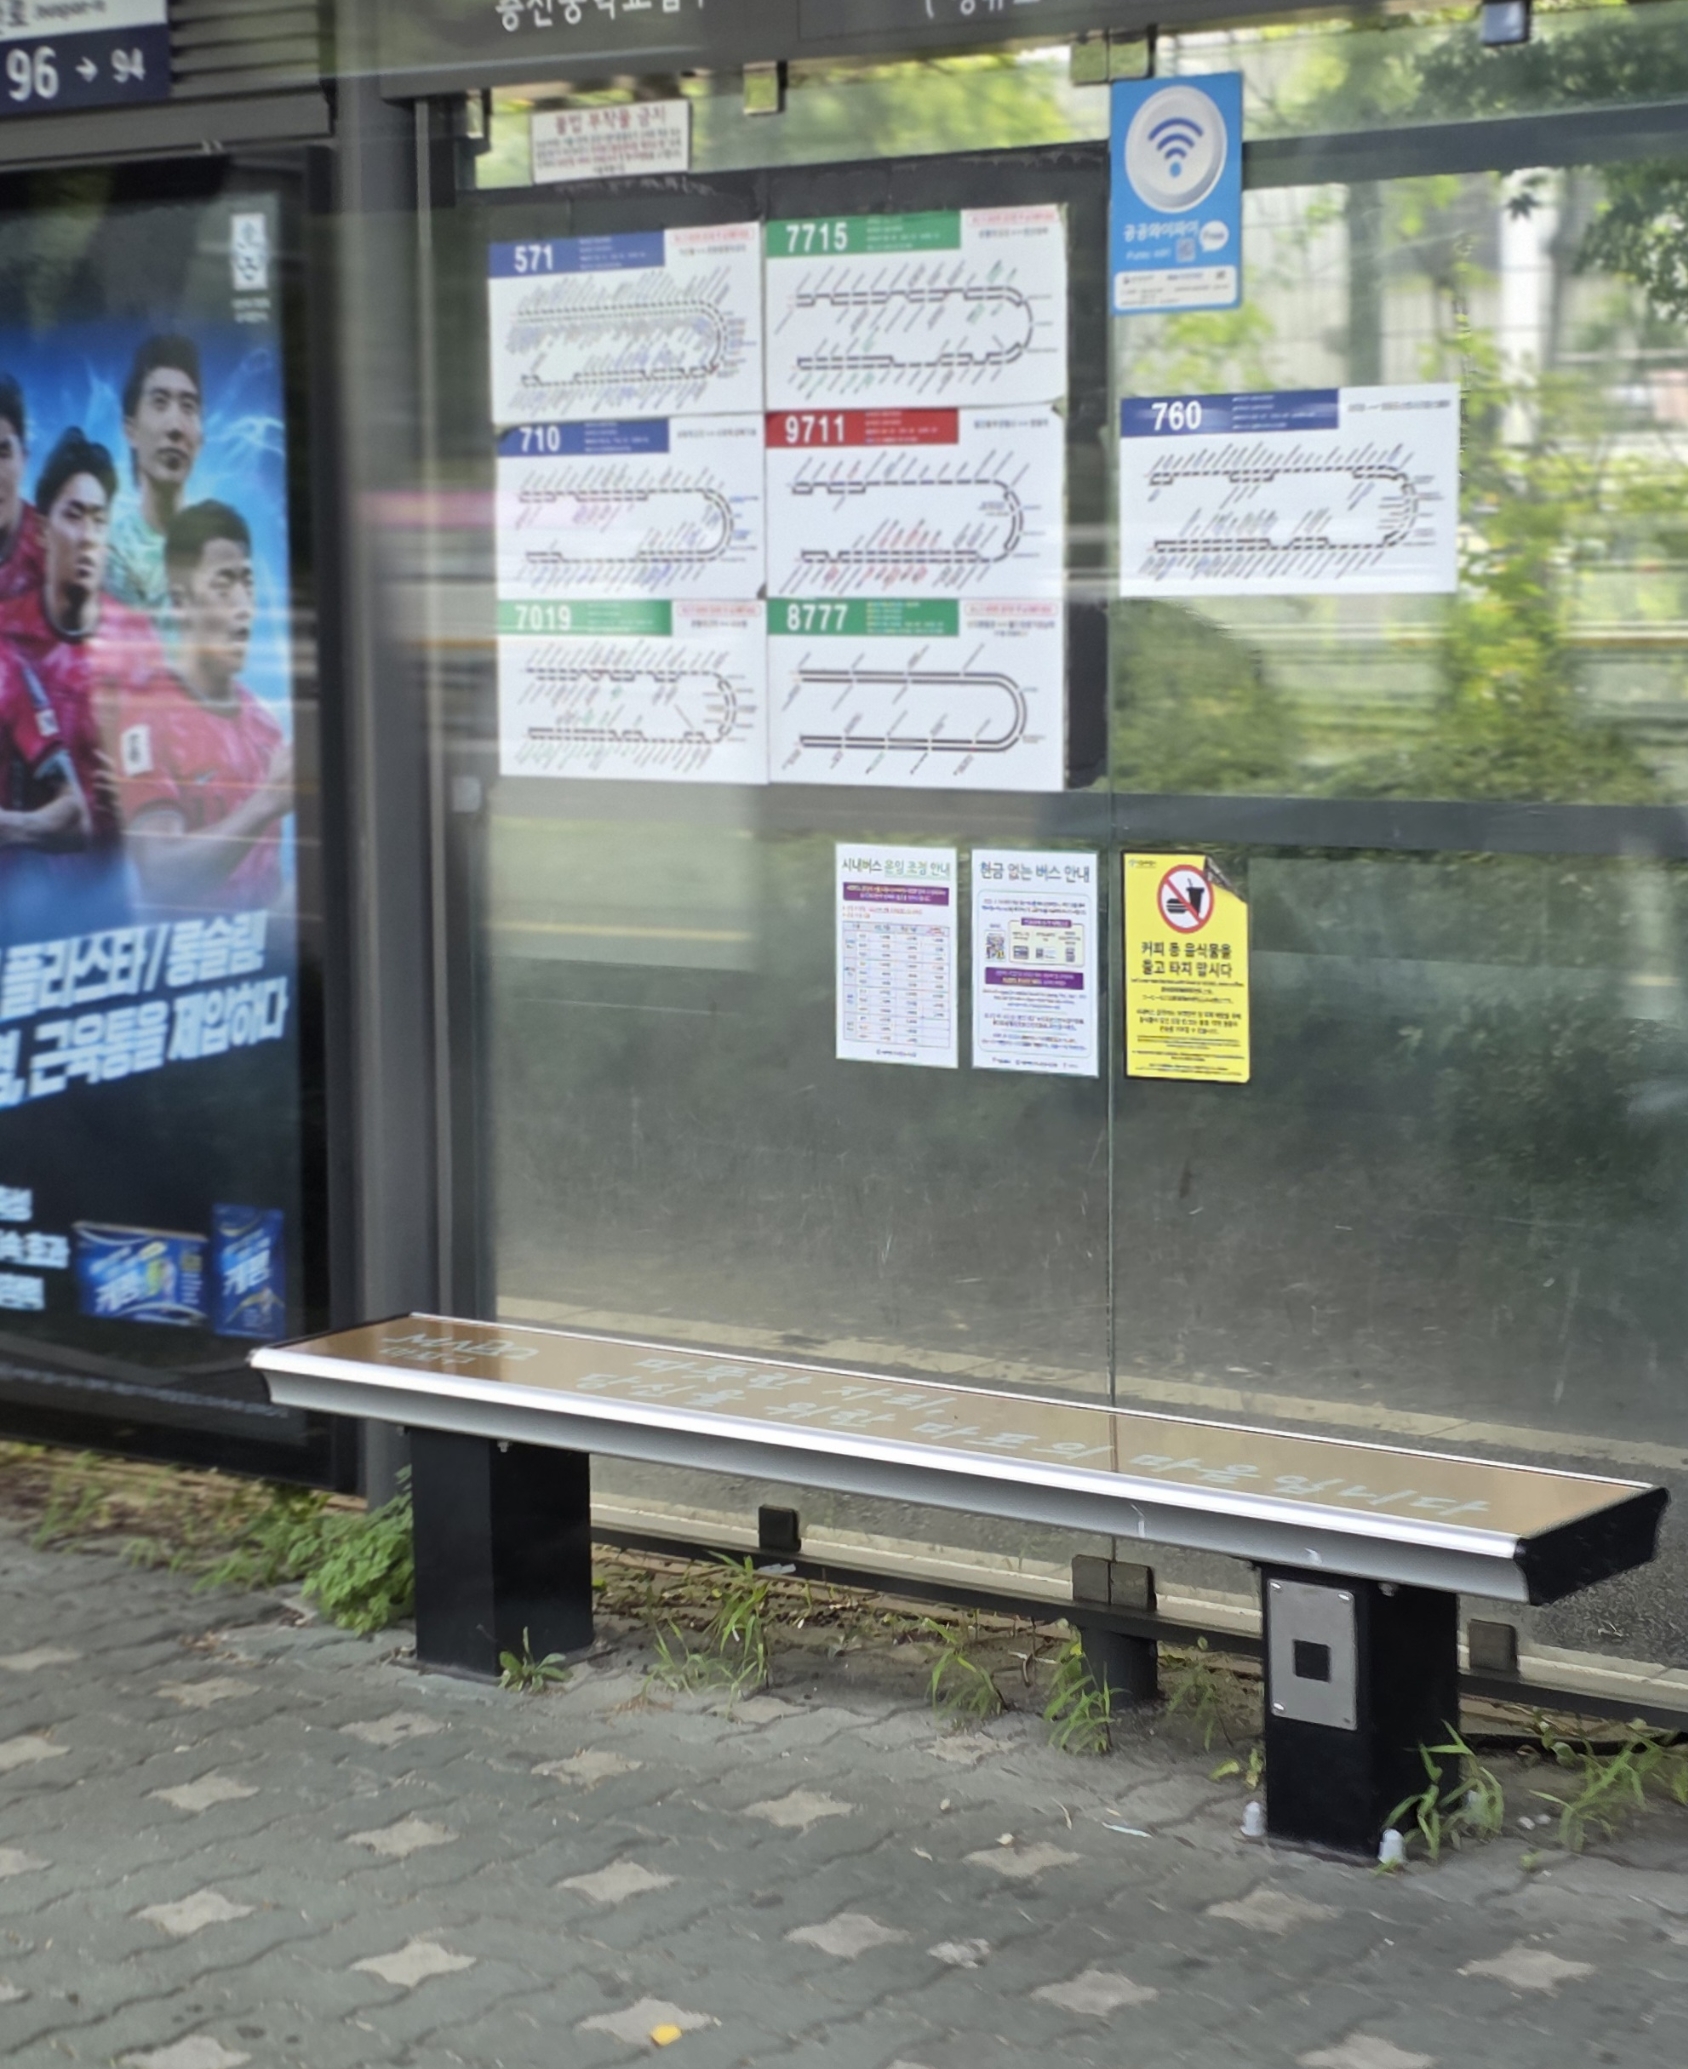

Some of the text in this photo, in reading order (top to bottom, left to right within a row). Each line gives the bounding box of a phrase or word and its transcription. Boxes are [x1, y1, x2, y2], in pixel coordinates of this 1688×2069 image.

[5, 46, 59, 101] 96
[785, 221, 848, 252] 7715
[514, 245, 553, 273] 571
[784, 414, 844, 443] 9711
[1151, 400, 1202, 431] 760
[519, 425, 560, 452] 710
[514, 604, 572, 631] 7019
[786, 603, 848, 631] 8777
[842, 857, 882, 874] 시내버스
[930, 862, 950, 877] 안내
[980, 861, 1090, 883] 현금 없는 버스 안내
[1141, 941, 1232, 960] 커피 등 음식물을
[1142, 959, 1165, 975] 들고
[1169, 961, 1193, 977] 타지
[28, 1000, 170, 1098] 근육통을
[632, 1358, 813, 1391] 따뜻한
[576, 1373, 1490, 1517] 당신을 위한 마포의 마음입니다
